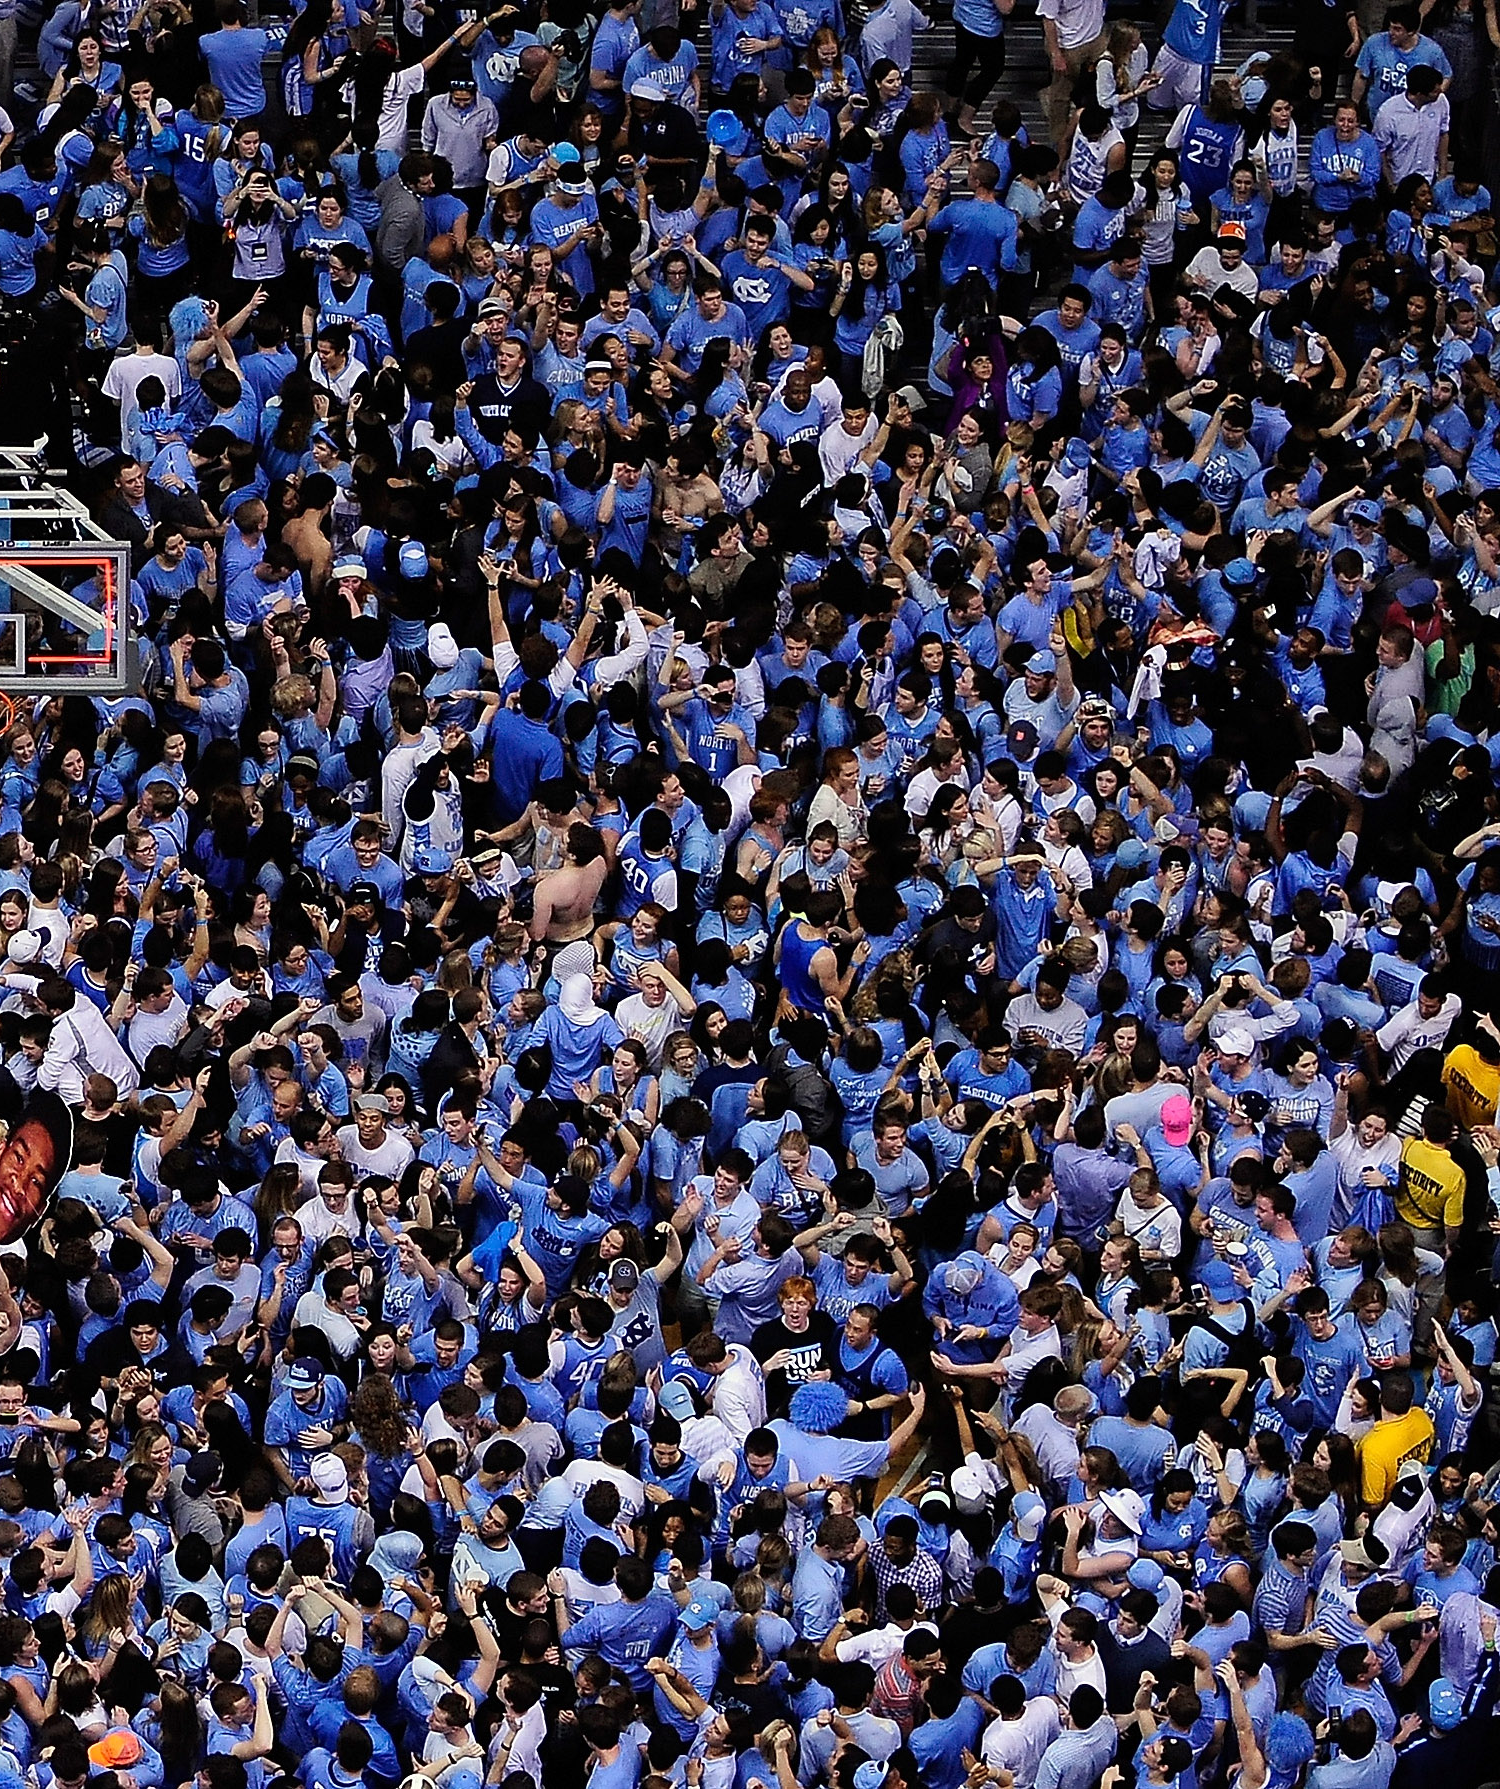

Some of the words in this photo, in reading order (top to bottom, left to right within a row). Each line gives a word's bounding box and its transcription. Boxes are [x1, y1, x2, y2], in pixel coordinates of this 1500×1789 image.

[1195, 20, 1207, 36] 3
[647, 65, 685, 85] ROLINA
[1381, 68, 1408, 89] BEA
[183, 132, 206, 163] 15
[1187, 139, 1224, 168] 23
[700, 736, 735, 751] NORTH
[708, 752, 718, 772] 1
[621, 857, 649, 894] 40
[960, 1085, 1007, 1105] CAROLINA
[1448, 1067, 1491, 1110] SECURITY
[946, 1297, 997, 1313] CARLINA
[788, 1349, 822, 1369] RUN
[1396, 1440, 1431, 1467] SECURITY
